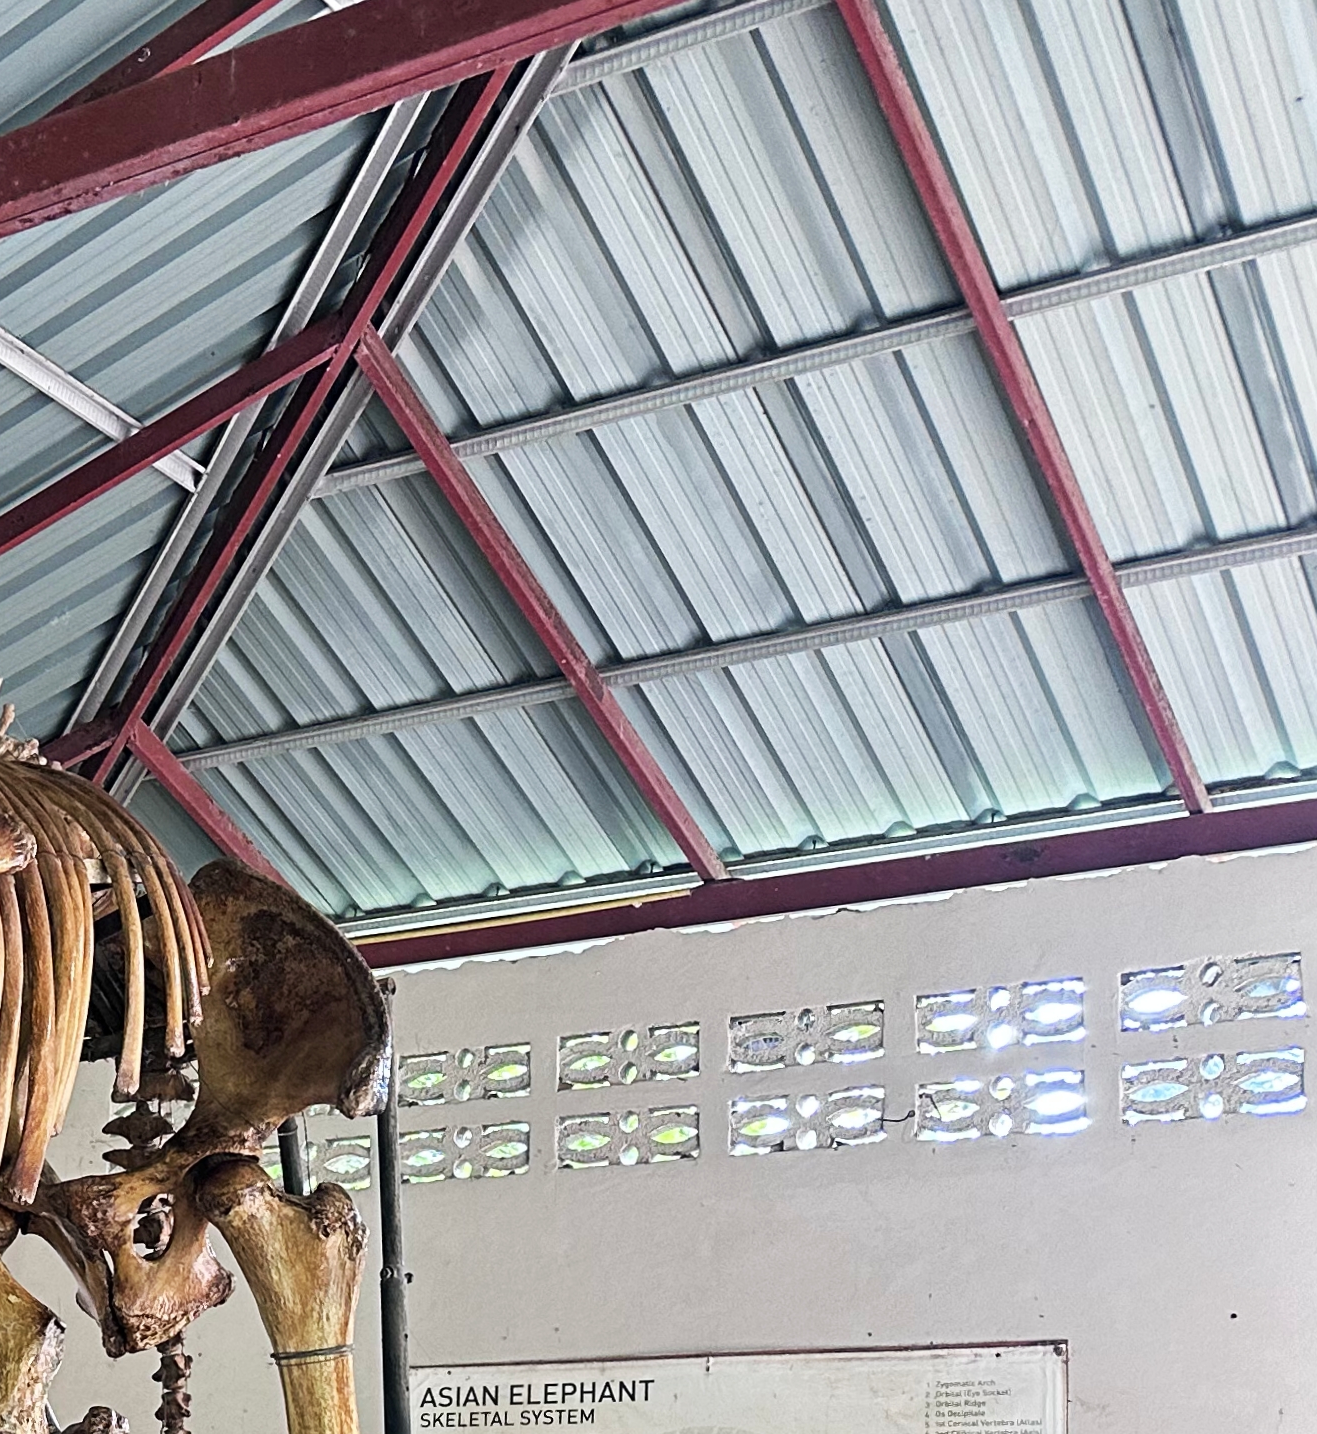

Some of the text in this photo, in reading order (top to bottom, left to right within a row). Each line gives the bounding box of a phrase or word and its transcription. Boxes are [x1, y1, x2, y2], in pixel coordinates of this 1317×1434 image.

[420, 1380, 654, 1408] ASIAN ELEPHANT
[420, 1409, 595, 1427] SKELETAL SYSTEM
